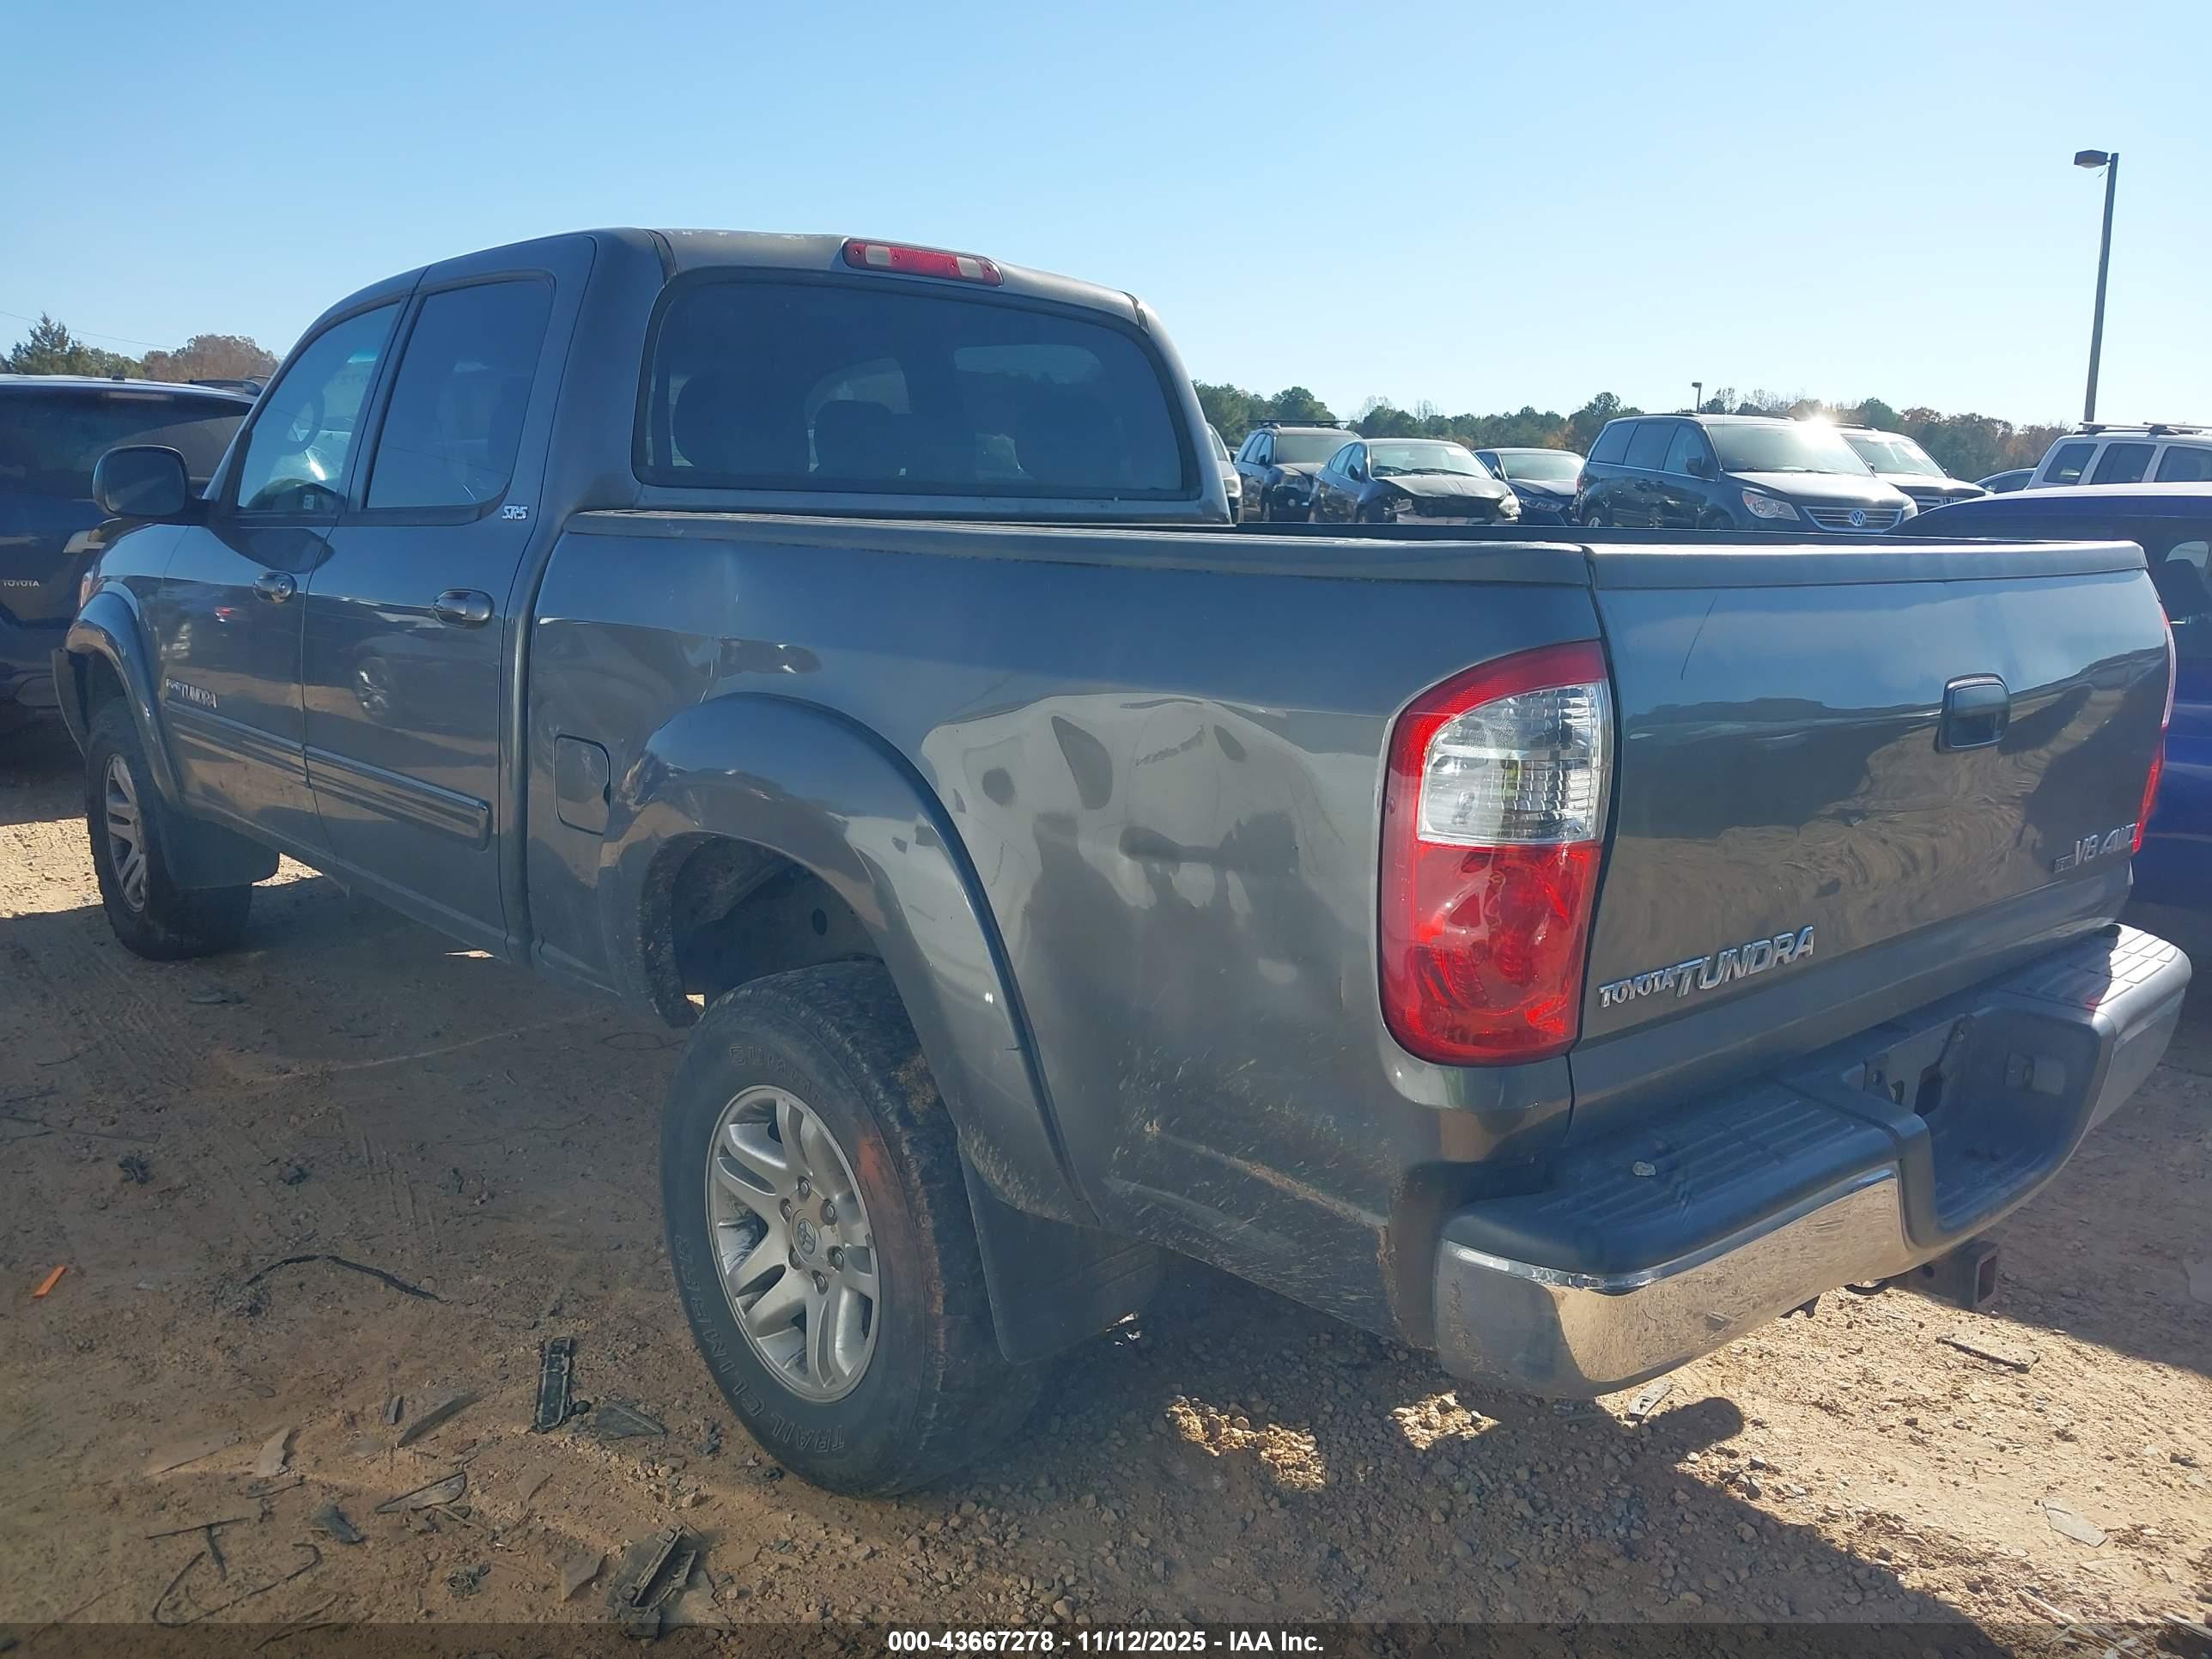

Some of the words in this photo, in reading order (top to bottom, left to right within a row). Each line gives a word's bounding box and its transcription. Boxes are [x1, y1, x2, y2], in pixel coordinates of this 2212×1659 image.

[2075, 835, 2098, 866] V8
[1598, 967, 1675, 1009] TOYOTA
[1674, 925, 1814, 998] TUNDRA
[770, 1413, 846, 1453] TRAIL
